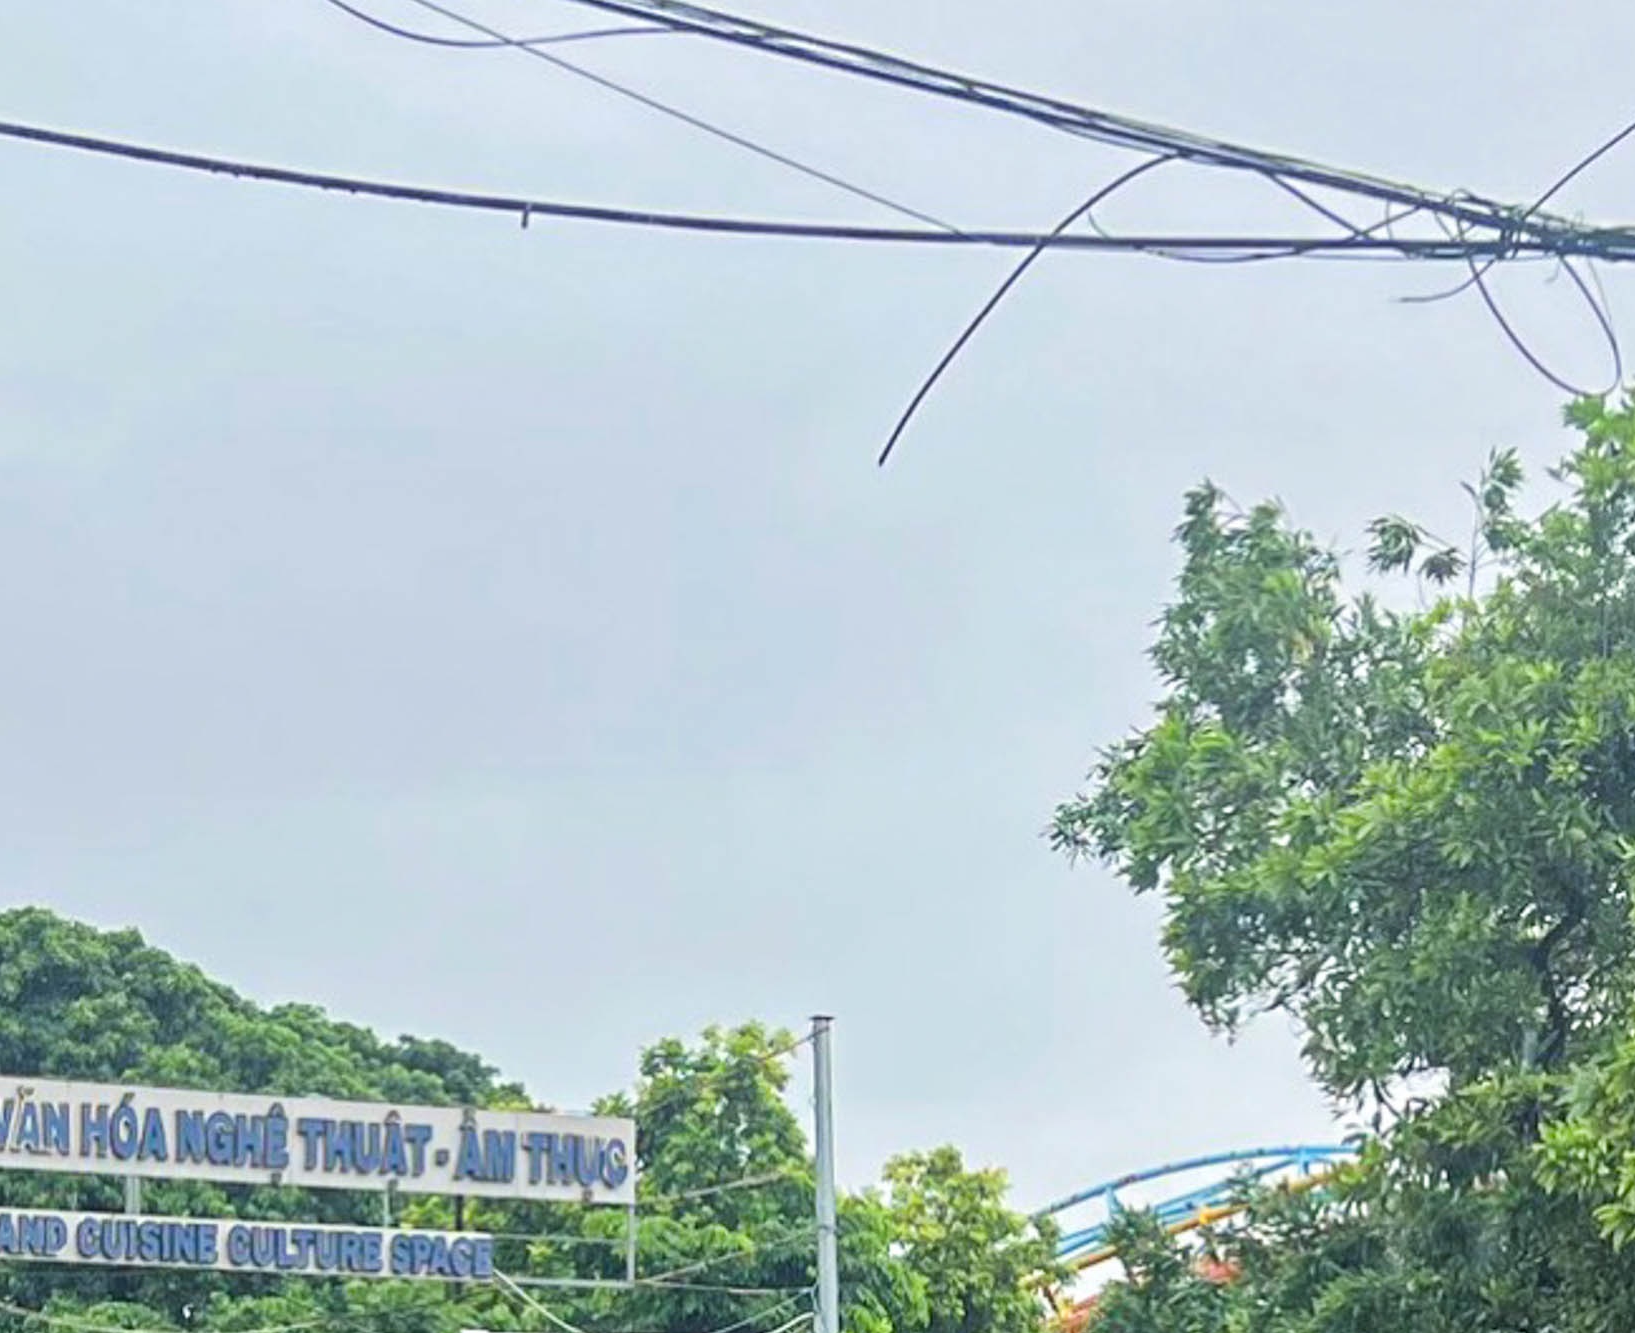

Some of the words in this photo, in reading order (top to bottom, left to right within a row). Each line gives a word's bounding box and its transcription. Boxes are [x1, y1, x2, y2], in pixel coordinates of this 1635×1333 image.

[79, 1091, 168, 1162] HÓA
[174, 1101, 290, 1187] NGHỆ
[296, 1109, 433, 1191] THUẬT
[520, 1130, 629, 1203] THỰC
[75, 1216, 219, 1266] CUISINE
[226, 1224, 384, 1273] CULTURE
[388, 1233, 495, 1278] SPACE
